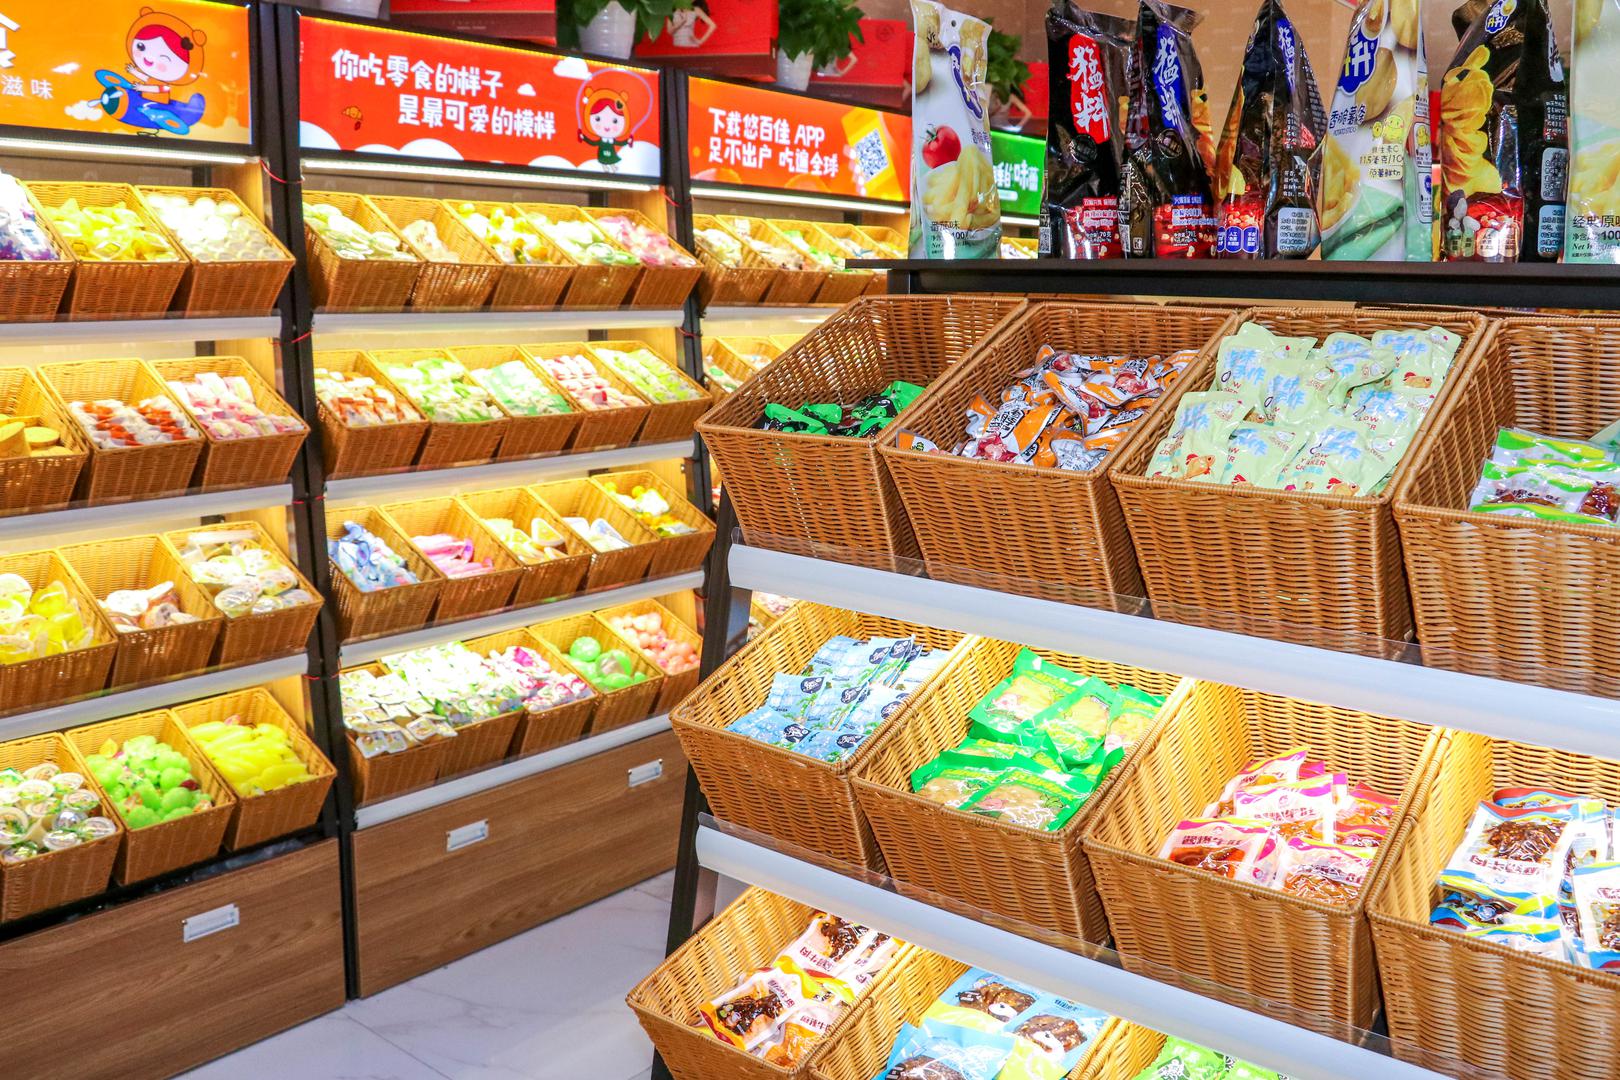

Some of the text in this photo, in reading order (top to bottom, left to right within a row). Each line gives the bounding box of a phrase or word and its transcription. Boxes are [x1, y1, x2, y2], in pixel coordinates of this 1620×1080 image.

[331, 48, 503, 98] 你吃零食的样子
[1066, 45, 1109, 139] 猛料
[398, 94, 556, 140] 是最可爱的模样
[708, 107, 825, 149] 下载悠百佳 APP
[1329, 104, 1366, 129] 香脆薯条
[708, 136, 839, 178] 足不出户 吃遍全球
